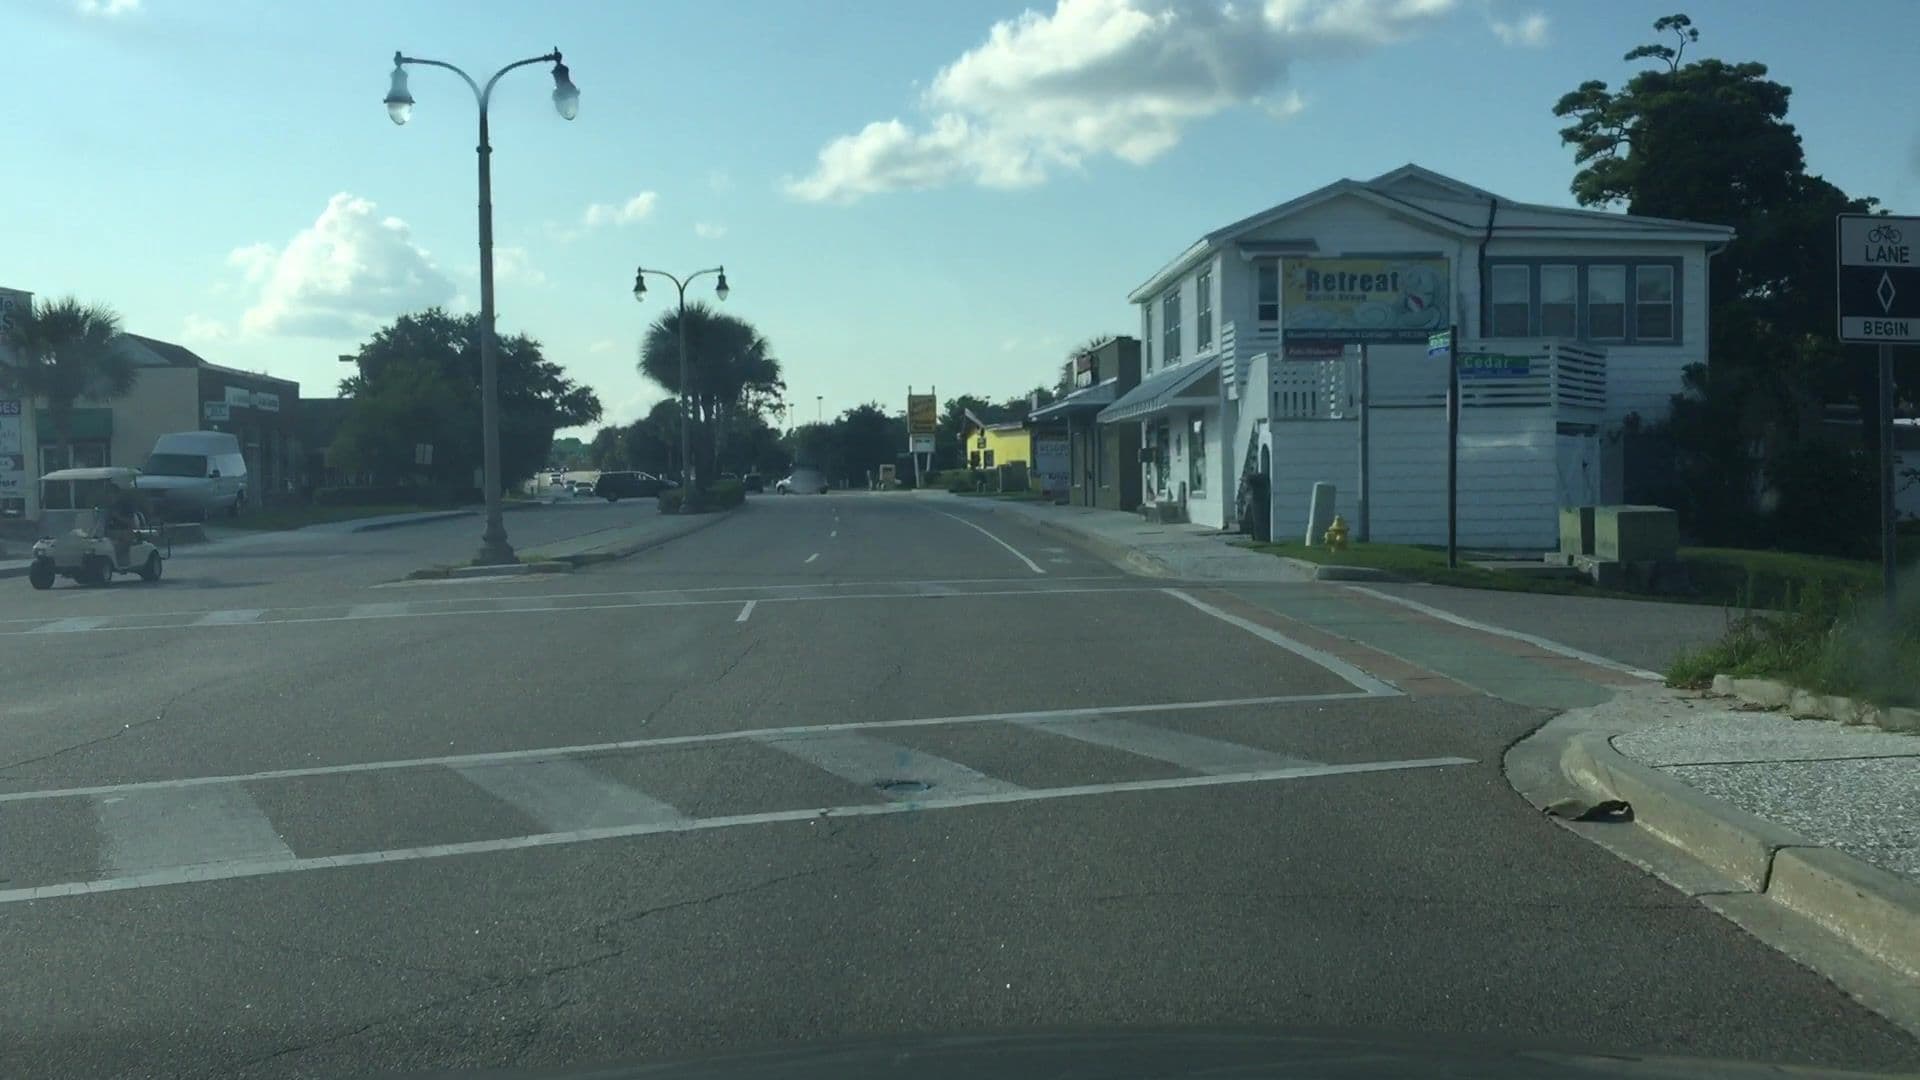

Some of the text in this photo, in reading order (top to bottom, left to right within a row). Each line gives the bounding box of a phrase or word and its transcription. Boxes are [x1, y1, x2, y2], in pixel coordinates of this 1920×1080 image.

[1865, 245, 1910, 263] LANE
[1305, 269, 1399, 292] Retreat
[1863, 321, 1909, 336] BEGIN
[1463, 355, 1512, 369] Cedar
